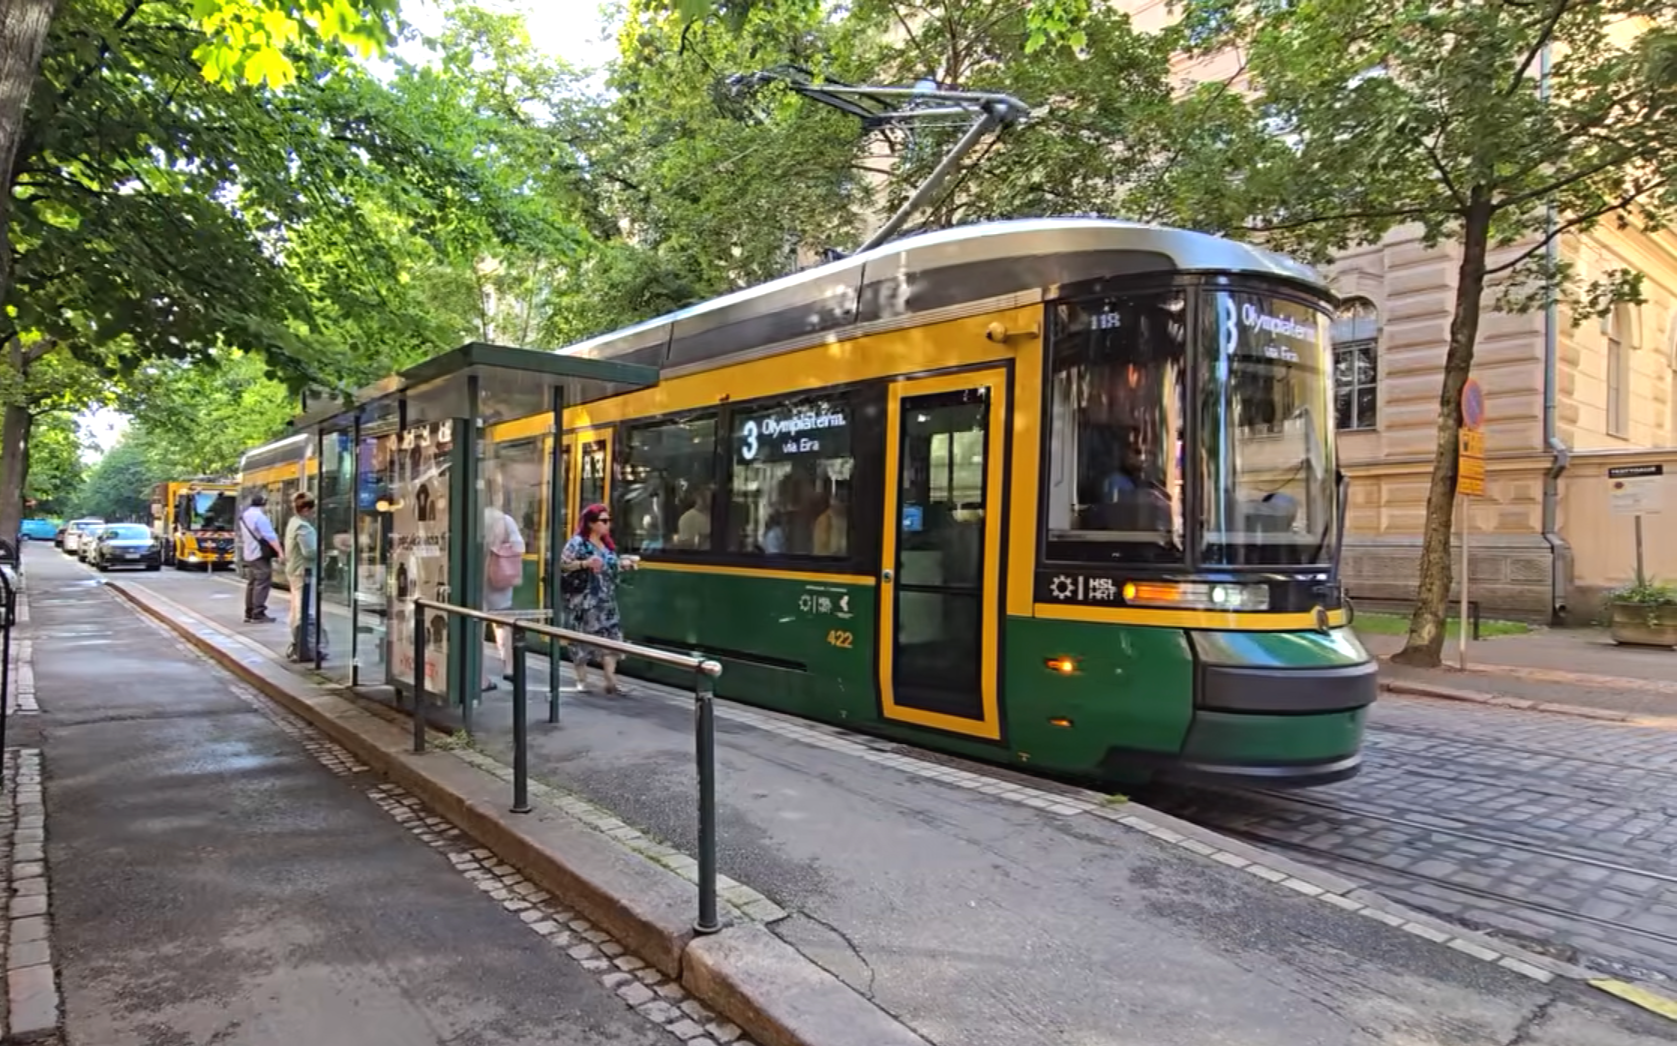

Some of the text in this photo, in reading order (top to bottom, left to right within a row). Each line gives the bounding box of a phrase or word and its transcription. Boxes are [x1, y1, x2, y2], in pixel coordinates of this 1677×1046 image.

[742, 420, 758, 460] 3
[782, 437, 820, 454] via Eira
[1088, 577, 1116, 590] HSL
[1088, 588, 1115, 601] HRT
[826, 629, 854, 649] 422
